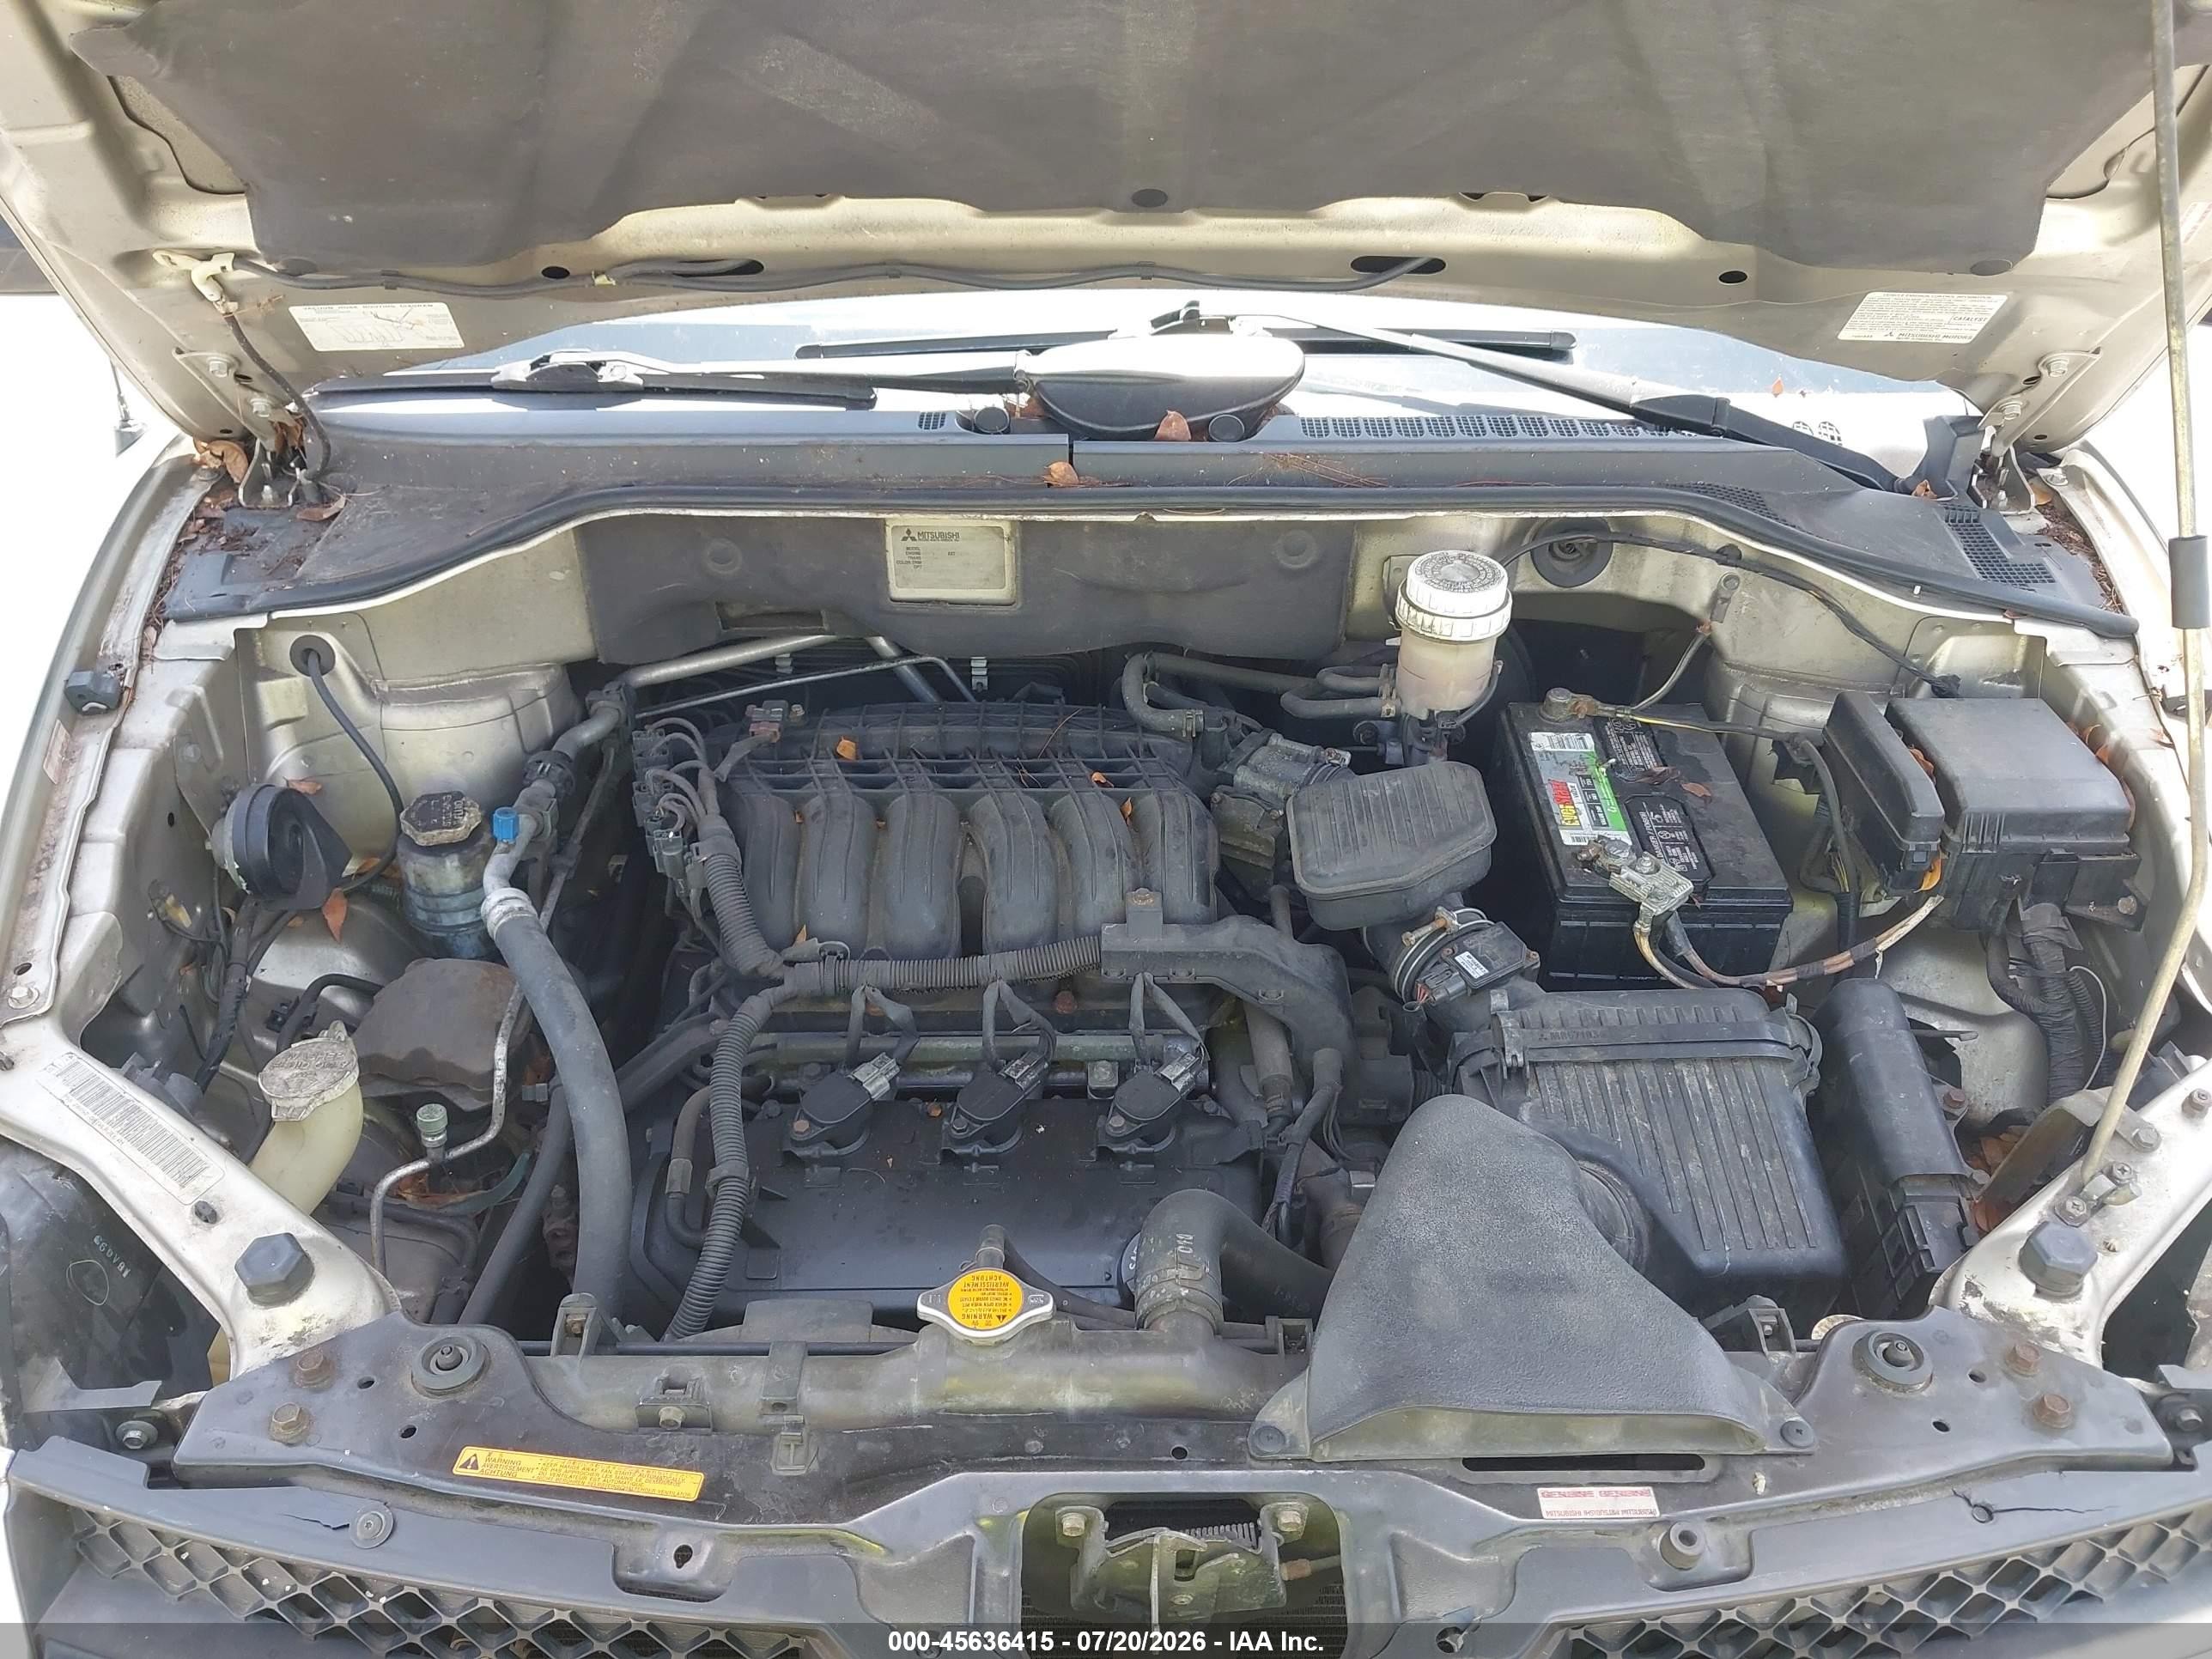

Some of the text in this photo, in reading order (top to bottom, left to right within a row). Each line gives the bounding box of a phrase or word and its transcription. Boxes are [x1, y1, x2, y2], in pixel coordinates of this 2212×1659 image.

[485, 1456, 521, 1466] WARNING
[479, 1468, 517, 1478] ACHTUNG
[482, 1462, 534, 1474] AVERTISSEMENT
